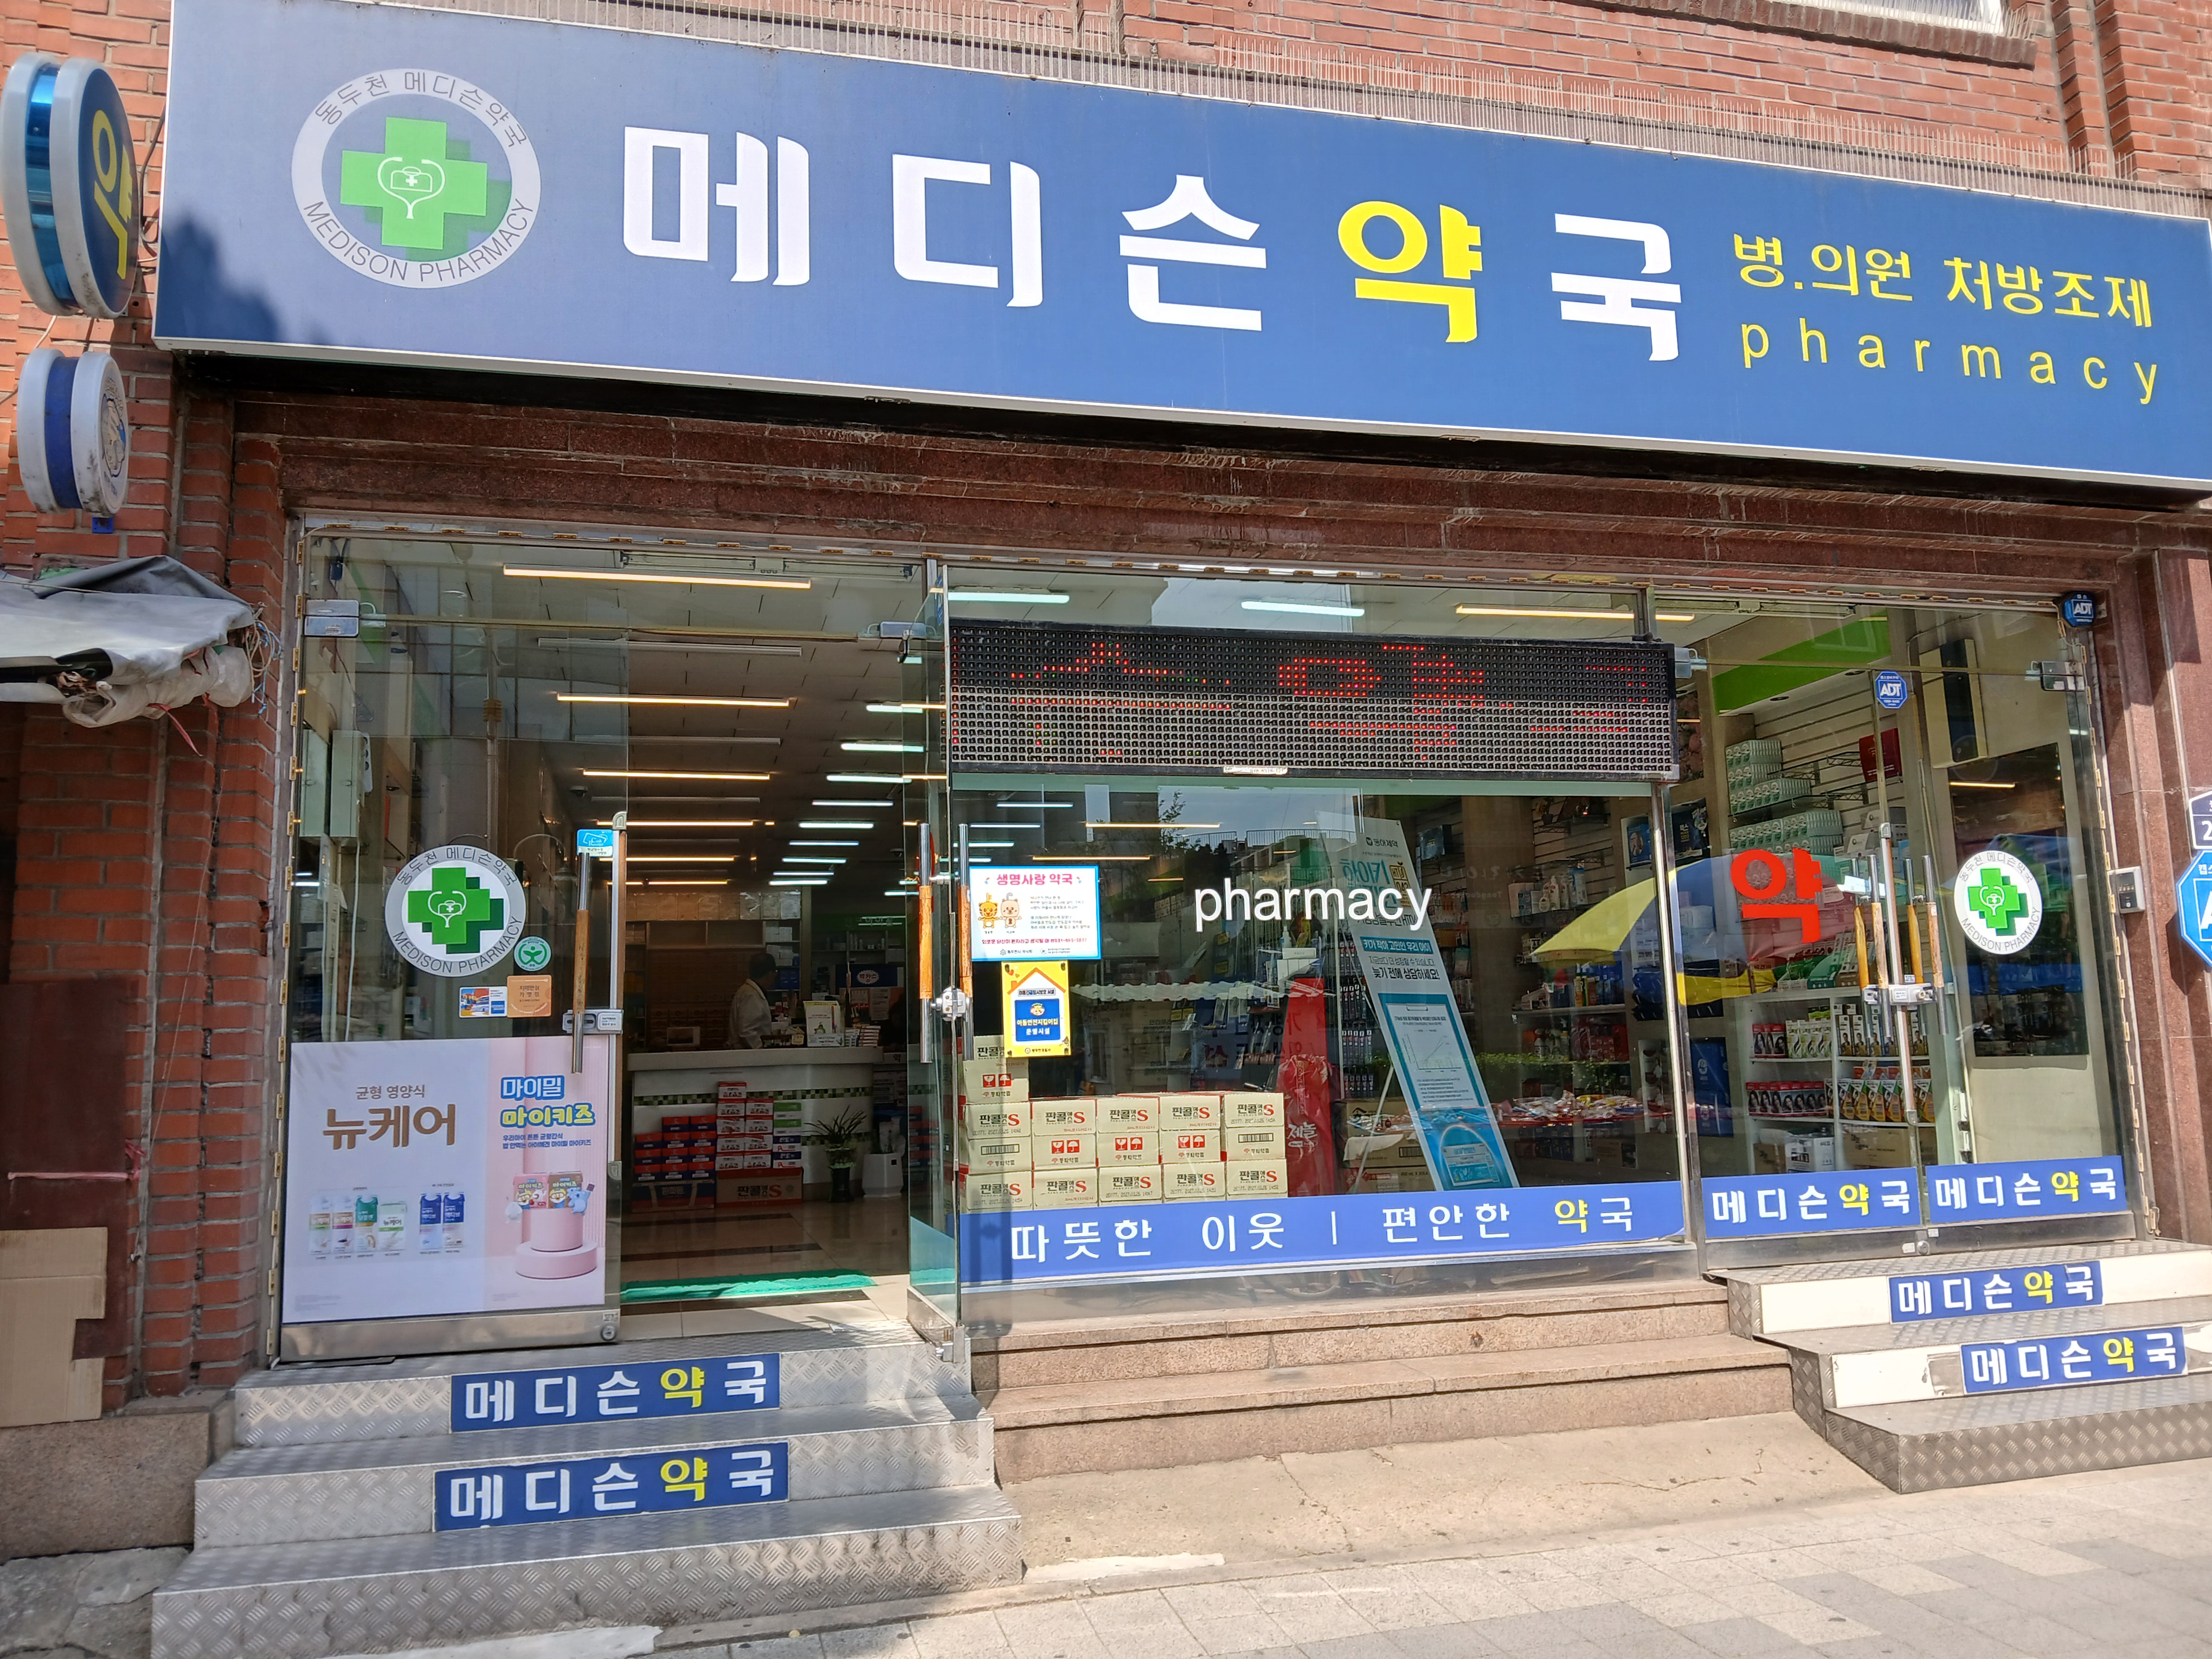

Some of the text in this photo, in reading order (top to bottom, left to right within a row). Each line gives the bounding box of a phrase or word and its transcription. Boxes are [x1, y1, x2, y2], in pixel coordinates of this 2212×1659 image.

[314, 72, 526, 149] 동두천 메디손약국
[92, 110, 132, 280] 약
[303, 199, 534, 283] MEDISON PHARMACY
[1733, 233, 2153, 328] 병.의원 처방조제
[1740, 317, 2157, 405] pharmacy
[2073, 602, 2092, 615] ADT
[1880, 683, 1902, 696] ADT
[396, 846, 517, 886] 동두천 메디손약국
[996, 873, 1073, 885] 생명사랑 약국
[1959, 852, 2034, 883] 동두천 메디손약국
[1194, 878, 1433, 933] pharmacy
[1730, 846, 1823, 943] 약
[393, 916, 523, 974] MEDISON PHARMACY
[1363, 939, 1376, 949] 키가
[1388, 941, 1406, 951] 고민인
[1406, 942, 1418, 951] 우리
[1418, 943, 1432, 953] 아이
[1961, 906, 2041, 951] MEDISON PHARMACY
[1372, 967, 1388, 979] 늦기
[1387, 967, 1403, 979] 전에
[1017, 1018, 1058, 1026] 아동안전지킴이집
[356, 1084, 426, 1099] 균형 영양식
[502, 1076, 562, 1099] 마이밀
[323, 1104, 456, 1150] 뉴케어
[501, 1104, 594, 1127] 마이키즈
[1712, 1180, 1910, 1224] 메디손약국
[1935, 1167, 2116, 1210] 메디손약국
[1011, 1197, 1633, 1264] 따뜻한 이웃 편안한 약국
[1898, 1266, 2094, 1315] 메디손약국
[1970, 1332, 2177, 1385] 메디손약국
[465, 1360, 767, 1423] 메디손약국
[450, 1450, 774, 1521] 메디손약국
